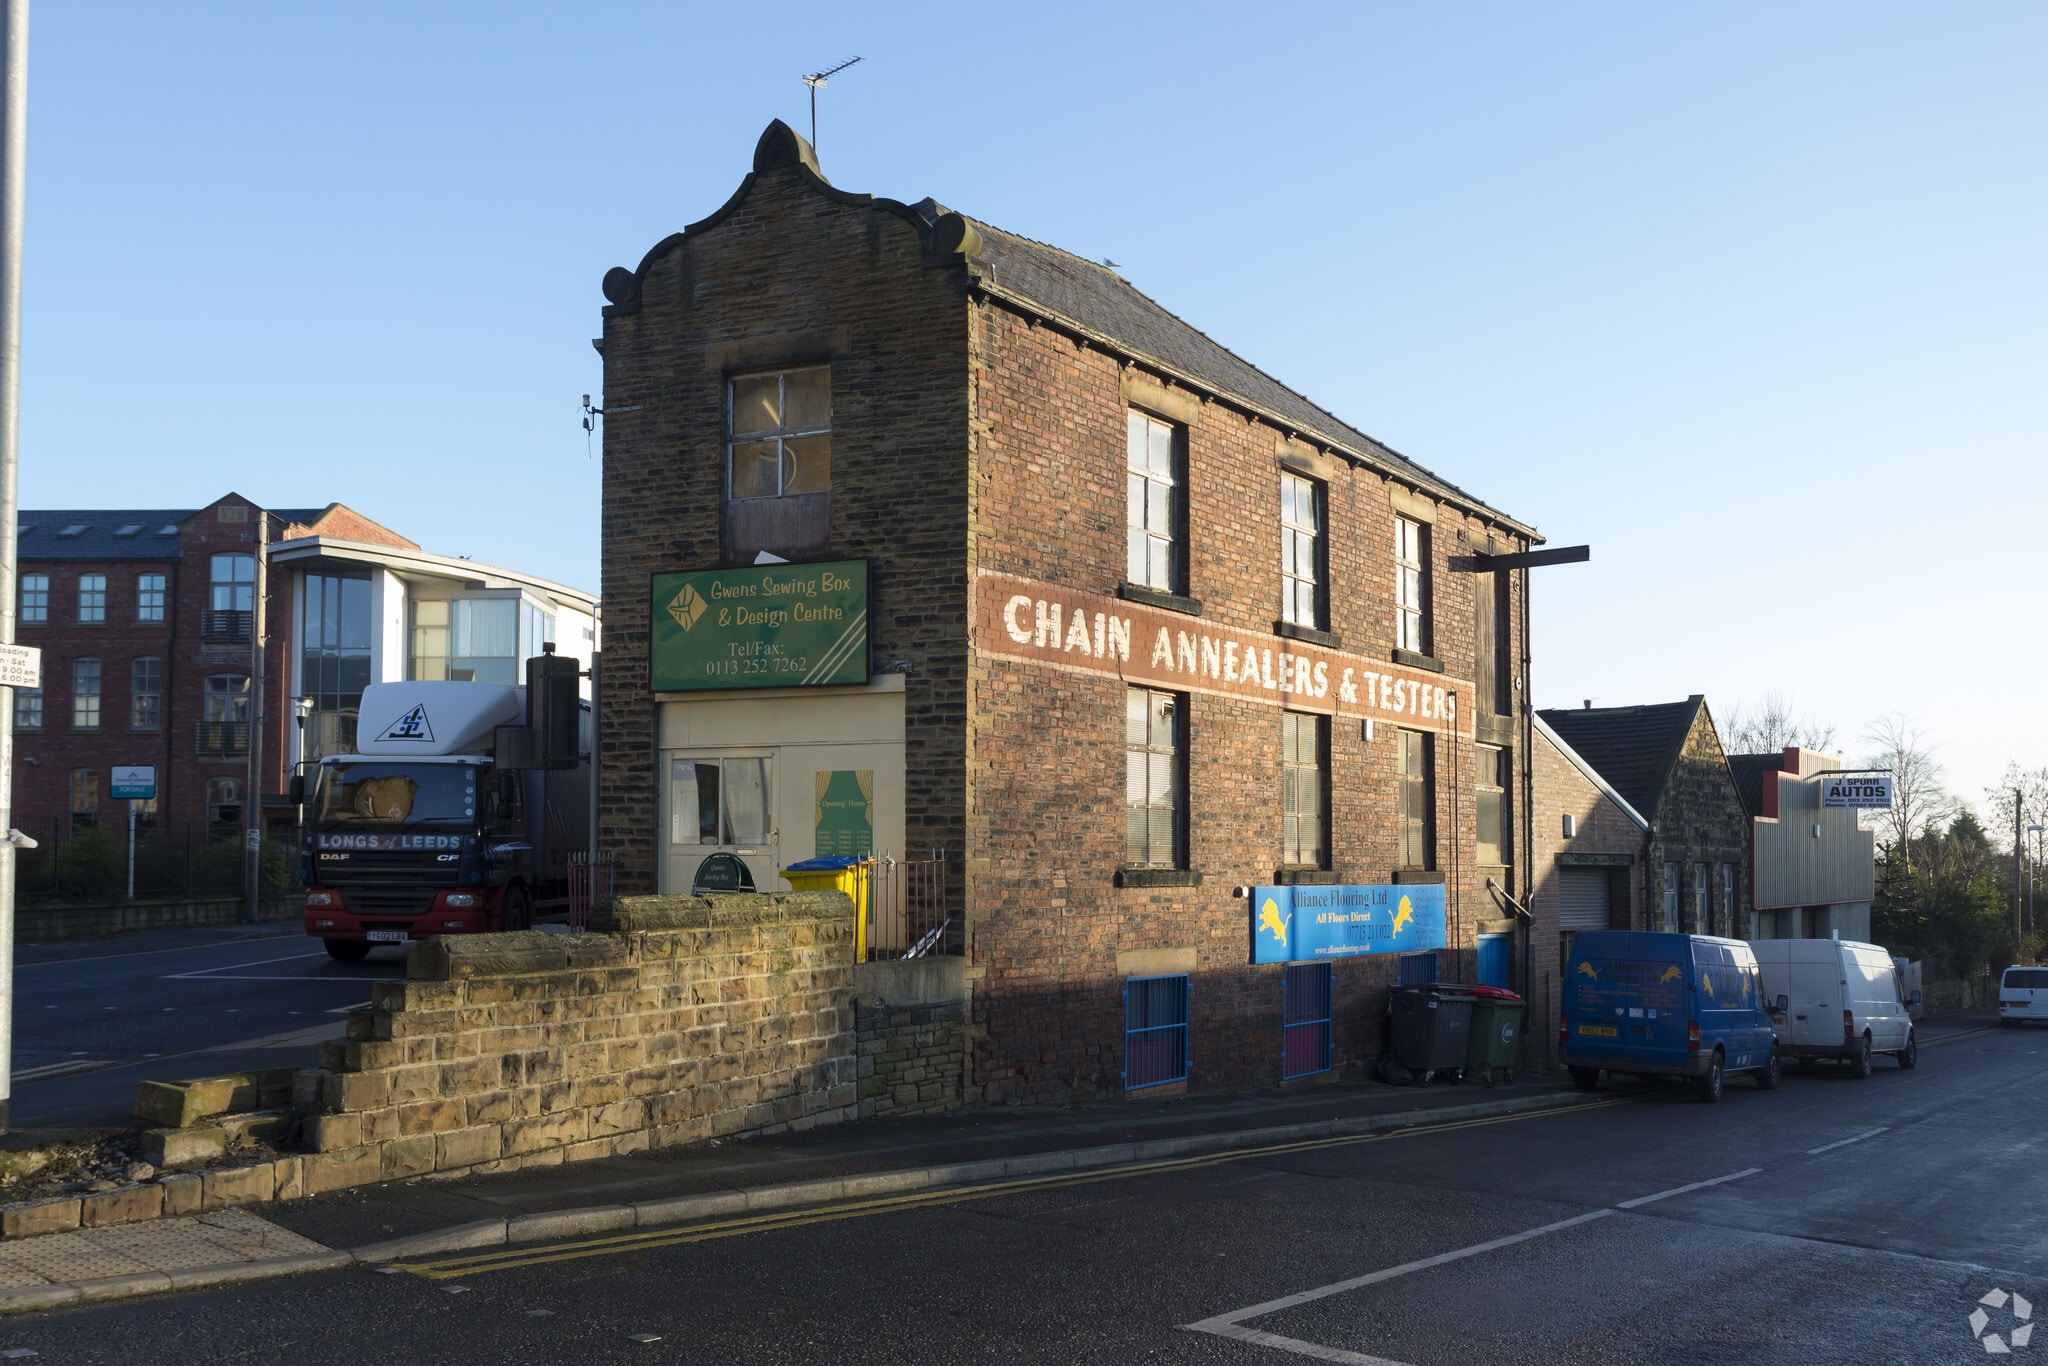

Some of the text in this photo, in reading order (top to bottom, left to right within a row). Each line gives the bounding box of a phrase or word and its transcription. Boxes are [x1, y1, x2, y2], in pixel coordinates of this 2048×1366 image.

[711, 572, 850, 600] Gwens Sewing Box
[718, 602, 843, 628] & Design Centre
[728, 641, 784, 657] Tel/Fax:
[11, 658, 26, 666] Sat
[706, 657, 807, 675] 0113 252 7262
[1003, 595, 1456, 722] CHAIN ANNEALERS & TESTERS
[1829, 786, 1886, 797] AUTOS
[319, 835, 461, 849] LONGS of LEEDS
[1289, 889, 1387, 910] Alliance Flooring Ltd
[1316, 911, 1371, 923] All Floors Direct
